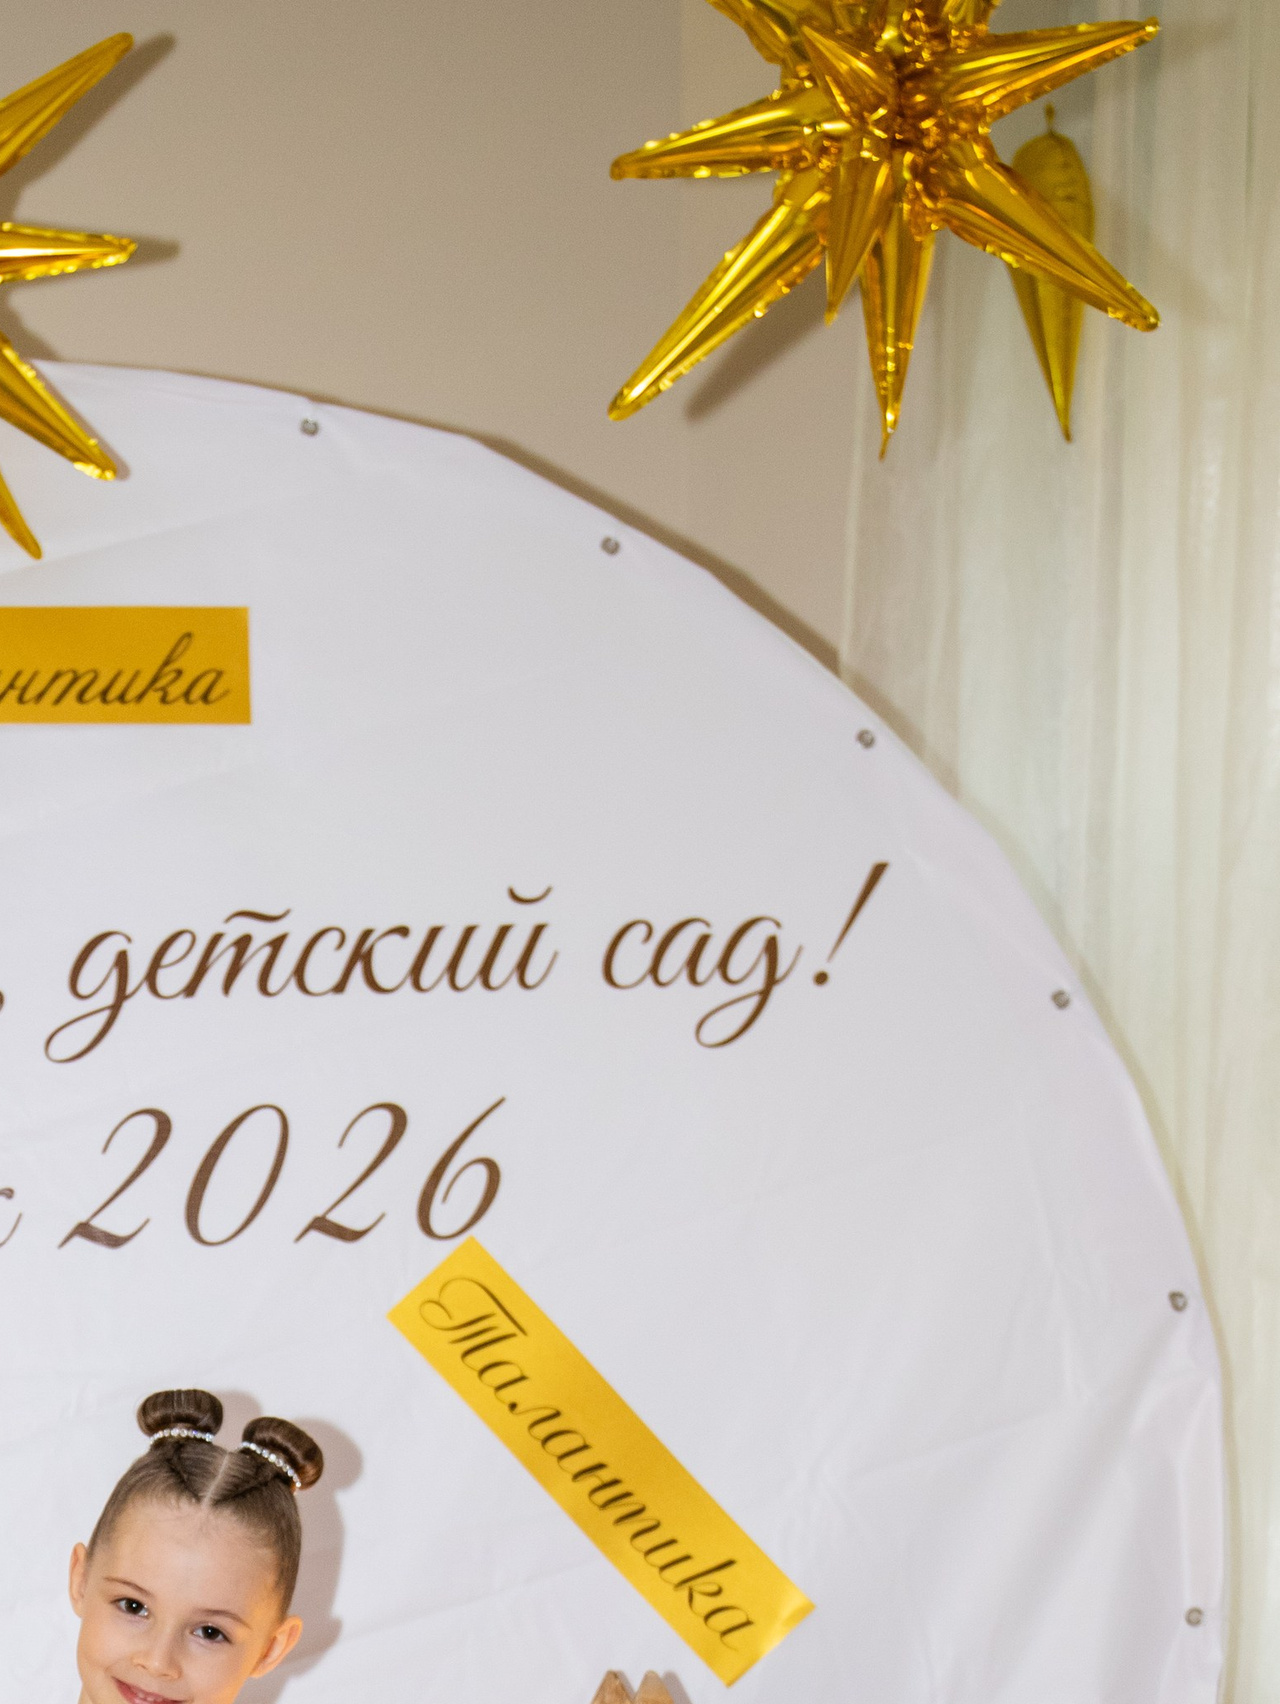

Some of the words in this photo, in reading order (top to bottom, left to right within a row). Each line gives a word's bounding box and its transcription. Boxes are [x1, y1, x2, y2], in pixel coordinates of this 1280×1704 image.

[44, 885, 558, 1063] детский
[601, 862, 890, 1049] сад!
[57, 1096, 507, 1249] 2026
[419, 1276, 755, 1651] Талантика
